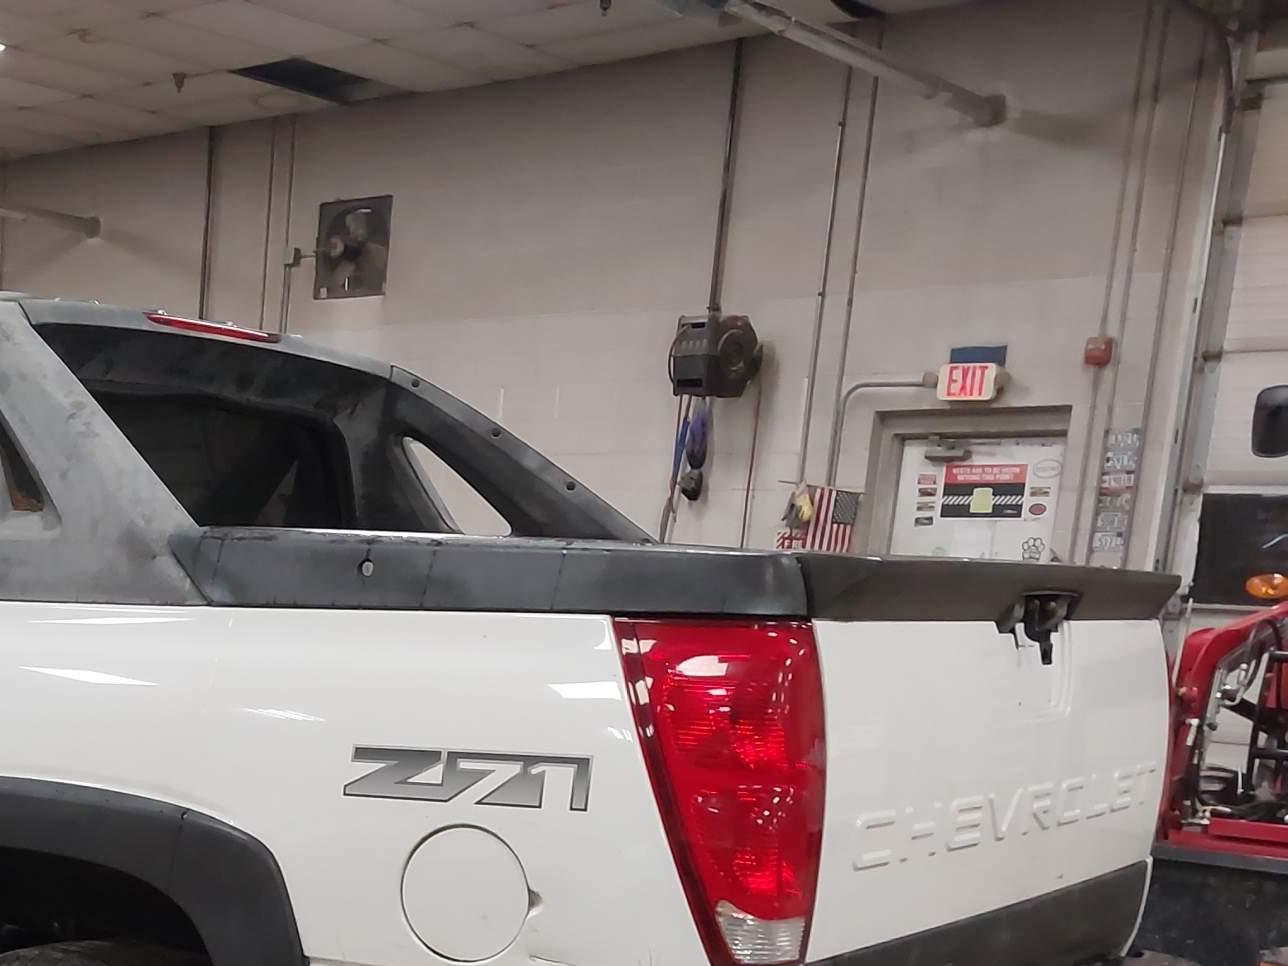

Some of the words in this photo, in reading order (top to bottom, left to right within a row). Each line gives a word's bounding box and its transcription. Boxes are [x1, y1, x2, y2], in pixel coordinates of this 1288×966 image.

[947, 365, 990, 398] EXIT
[342, 744, 594, 812] Z71
[852, 761, 1158, 871] CHEVROLET
